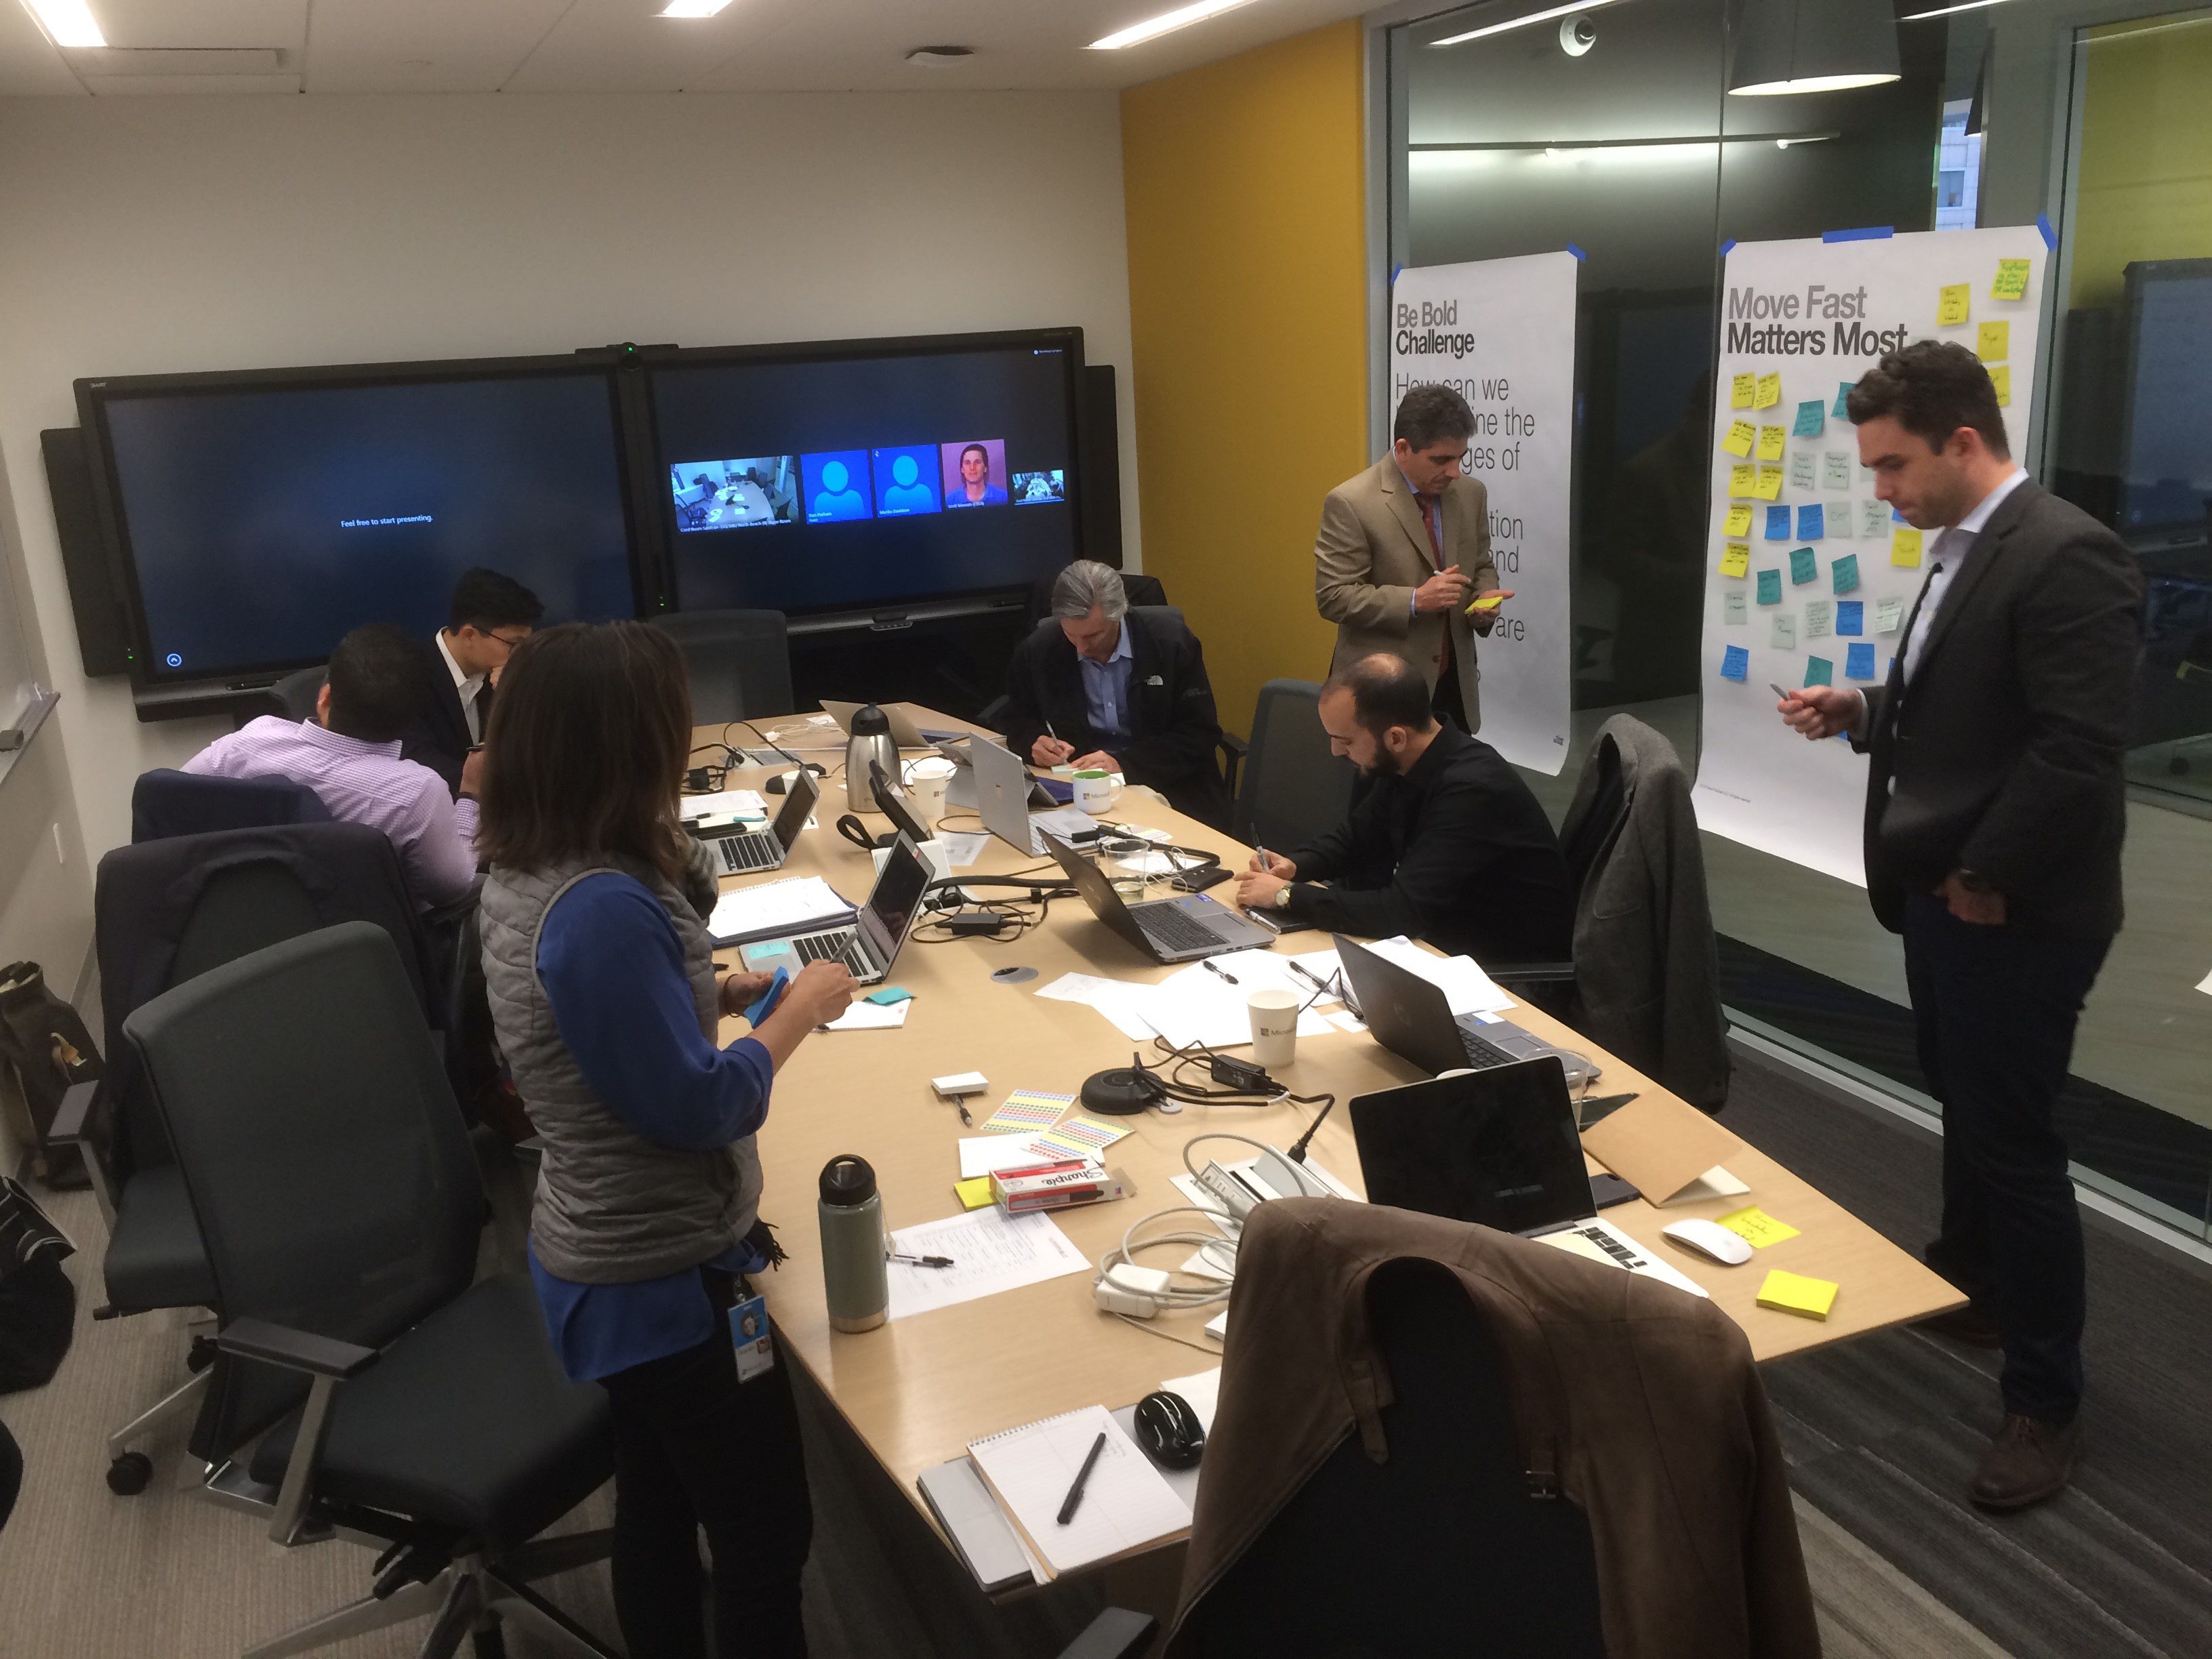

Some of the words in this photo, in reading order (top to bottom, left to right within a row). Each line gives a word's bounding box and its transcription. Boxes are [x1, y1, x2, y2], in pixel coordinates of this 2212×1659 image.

[1397, 303, 1418, 329] Be
[1422, 299, 1457, 327] Bold
[1728, 287, 1800, 320] Move
[1806, 285, 1868, 319] Fast
[1396, 329, 1475, 359] Challenge
[1727, 322, 1826, 356] Matters
[1832, 321, 1908, 356] Most
[1481, 378, 1509, 401] we
[1504, 407, 1535, 436] the
[1502, 441, 1520, 470] of
[396, 514, 434, 525] presenting.
[1044, 1167, 1104, 1185] Sharpie
